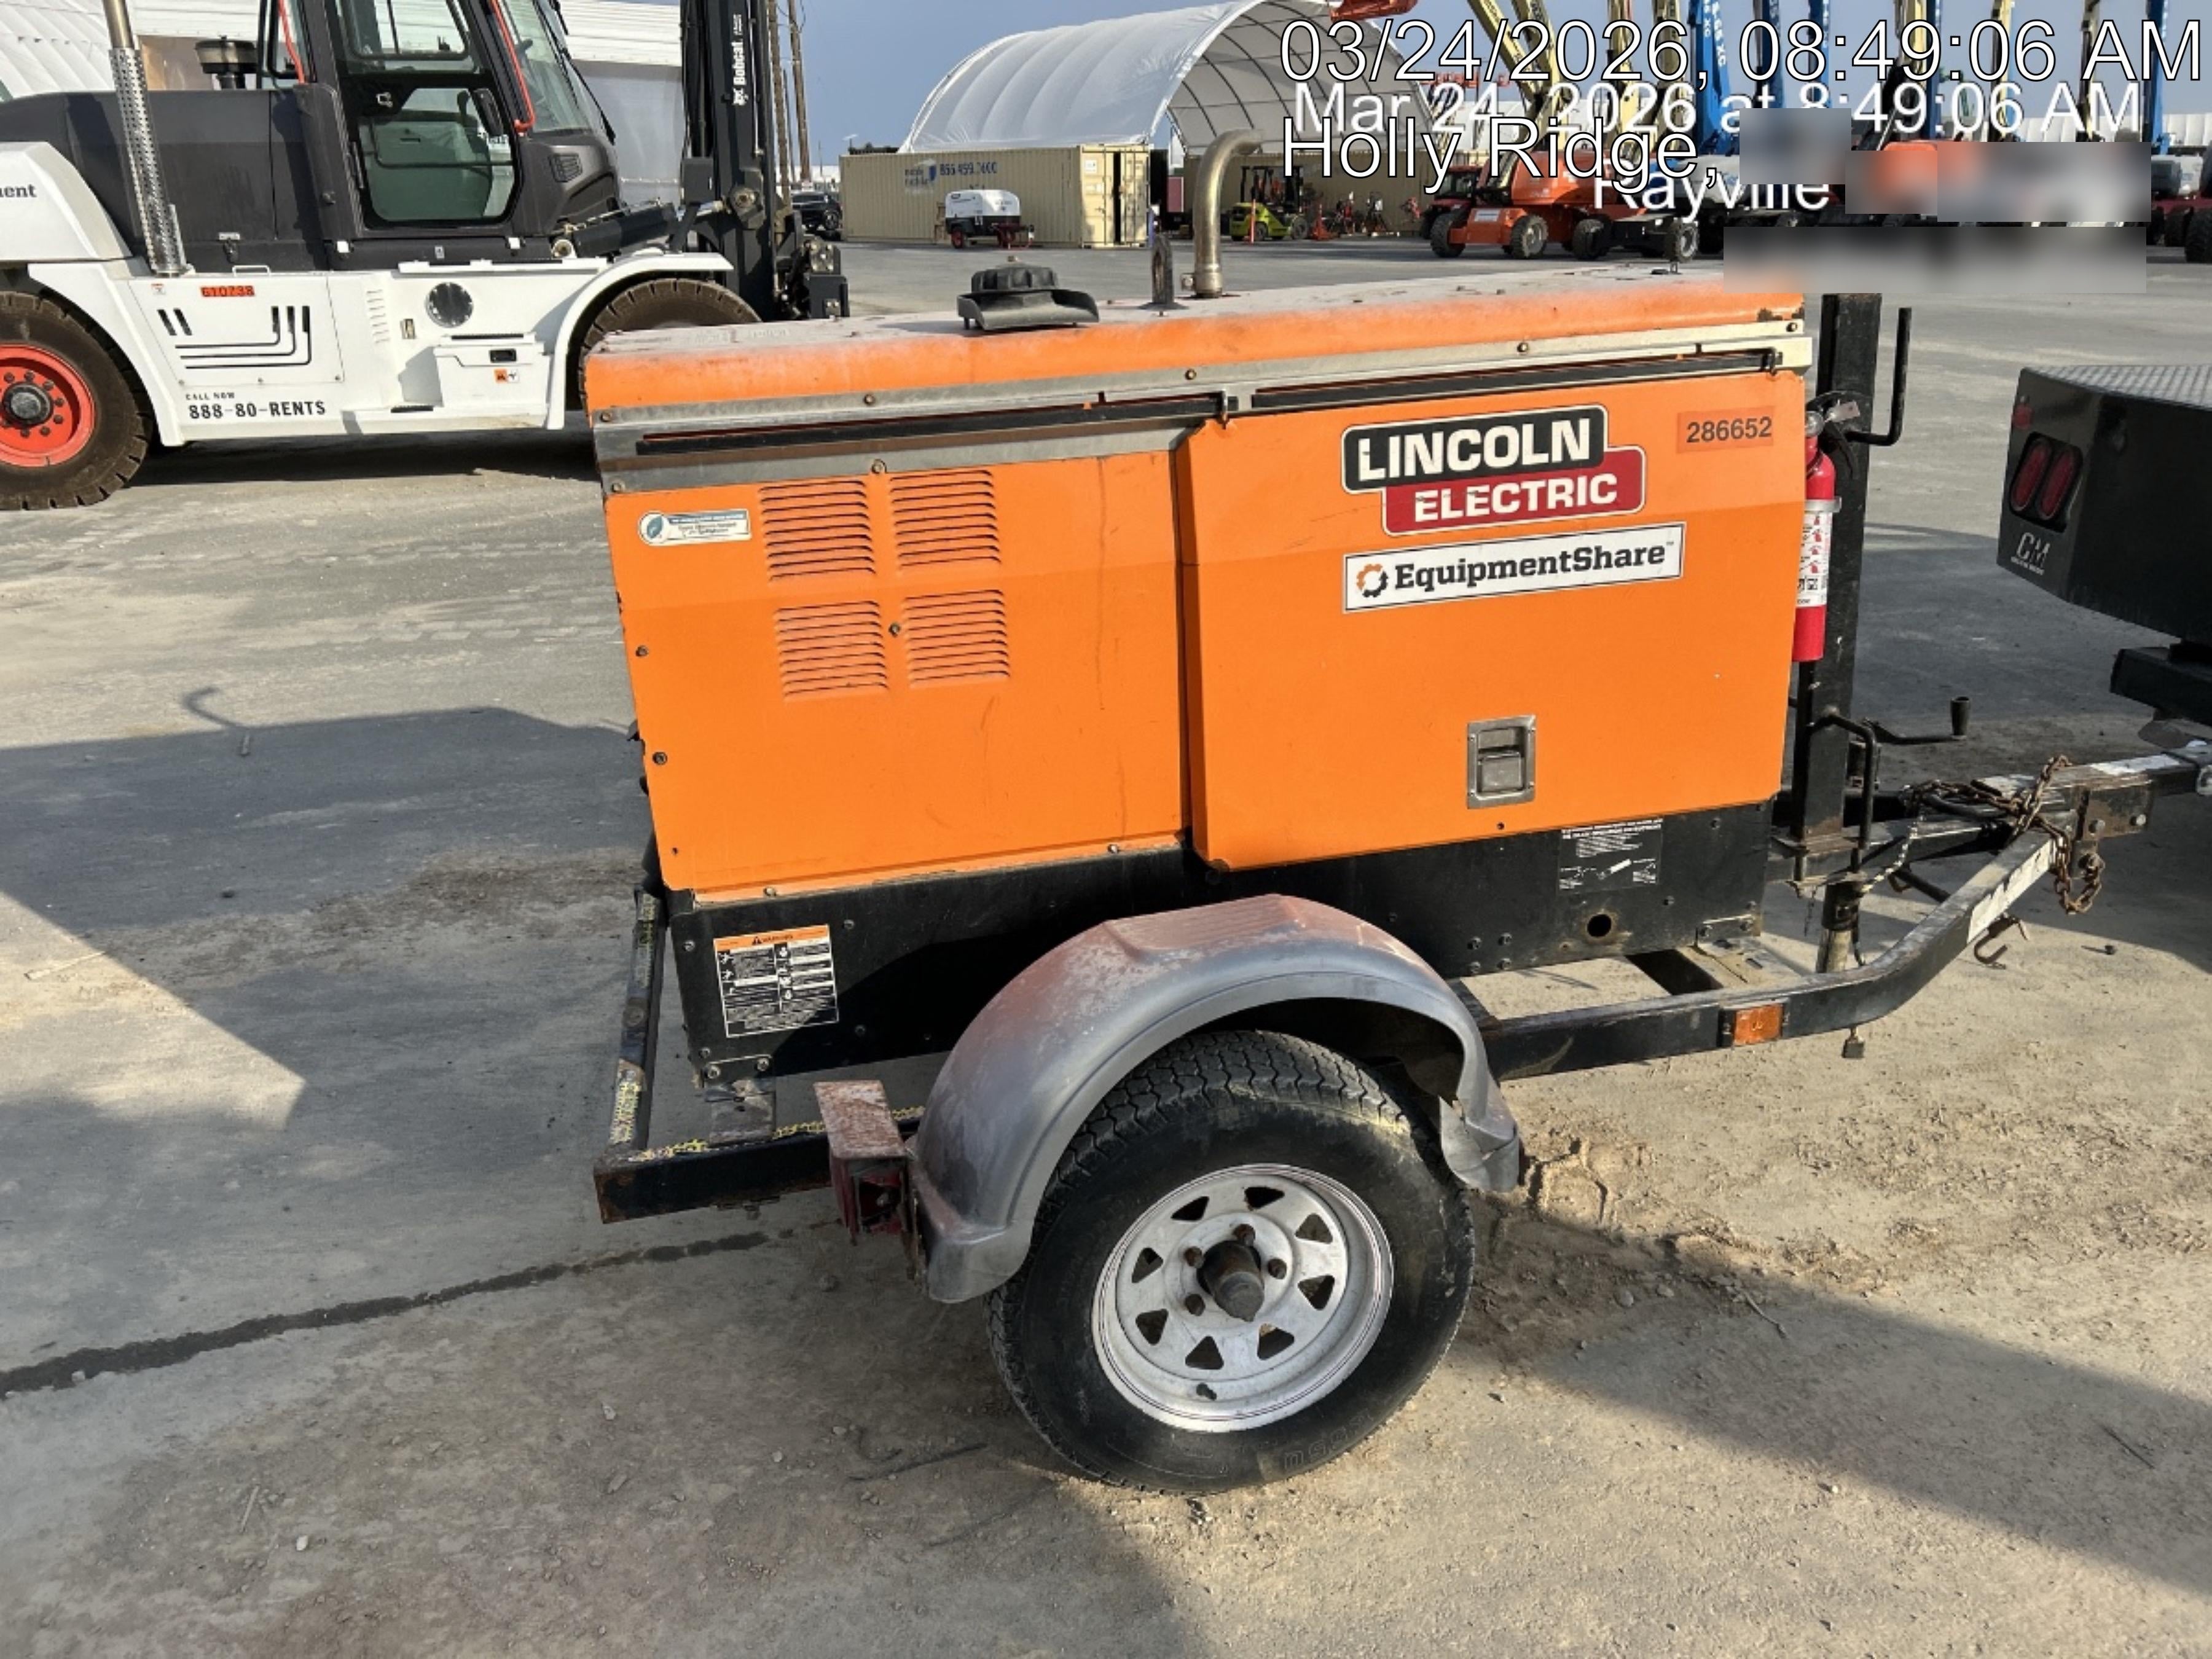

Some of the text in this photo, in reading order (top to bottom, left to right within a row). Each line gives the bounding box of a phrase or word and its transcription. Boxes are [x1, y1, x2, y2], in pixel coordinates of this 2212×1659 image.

[731, 42, 746, 85] Bobcat
[189, 400, 326, 419] 888-80-RENTS
[1686, 416, 1772, 443] 286652
[1357, 418, 1590, 482] LINCOLN
[1414, 473, 1618, 522] ELECTRIC
